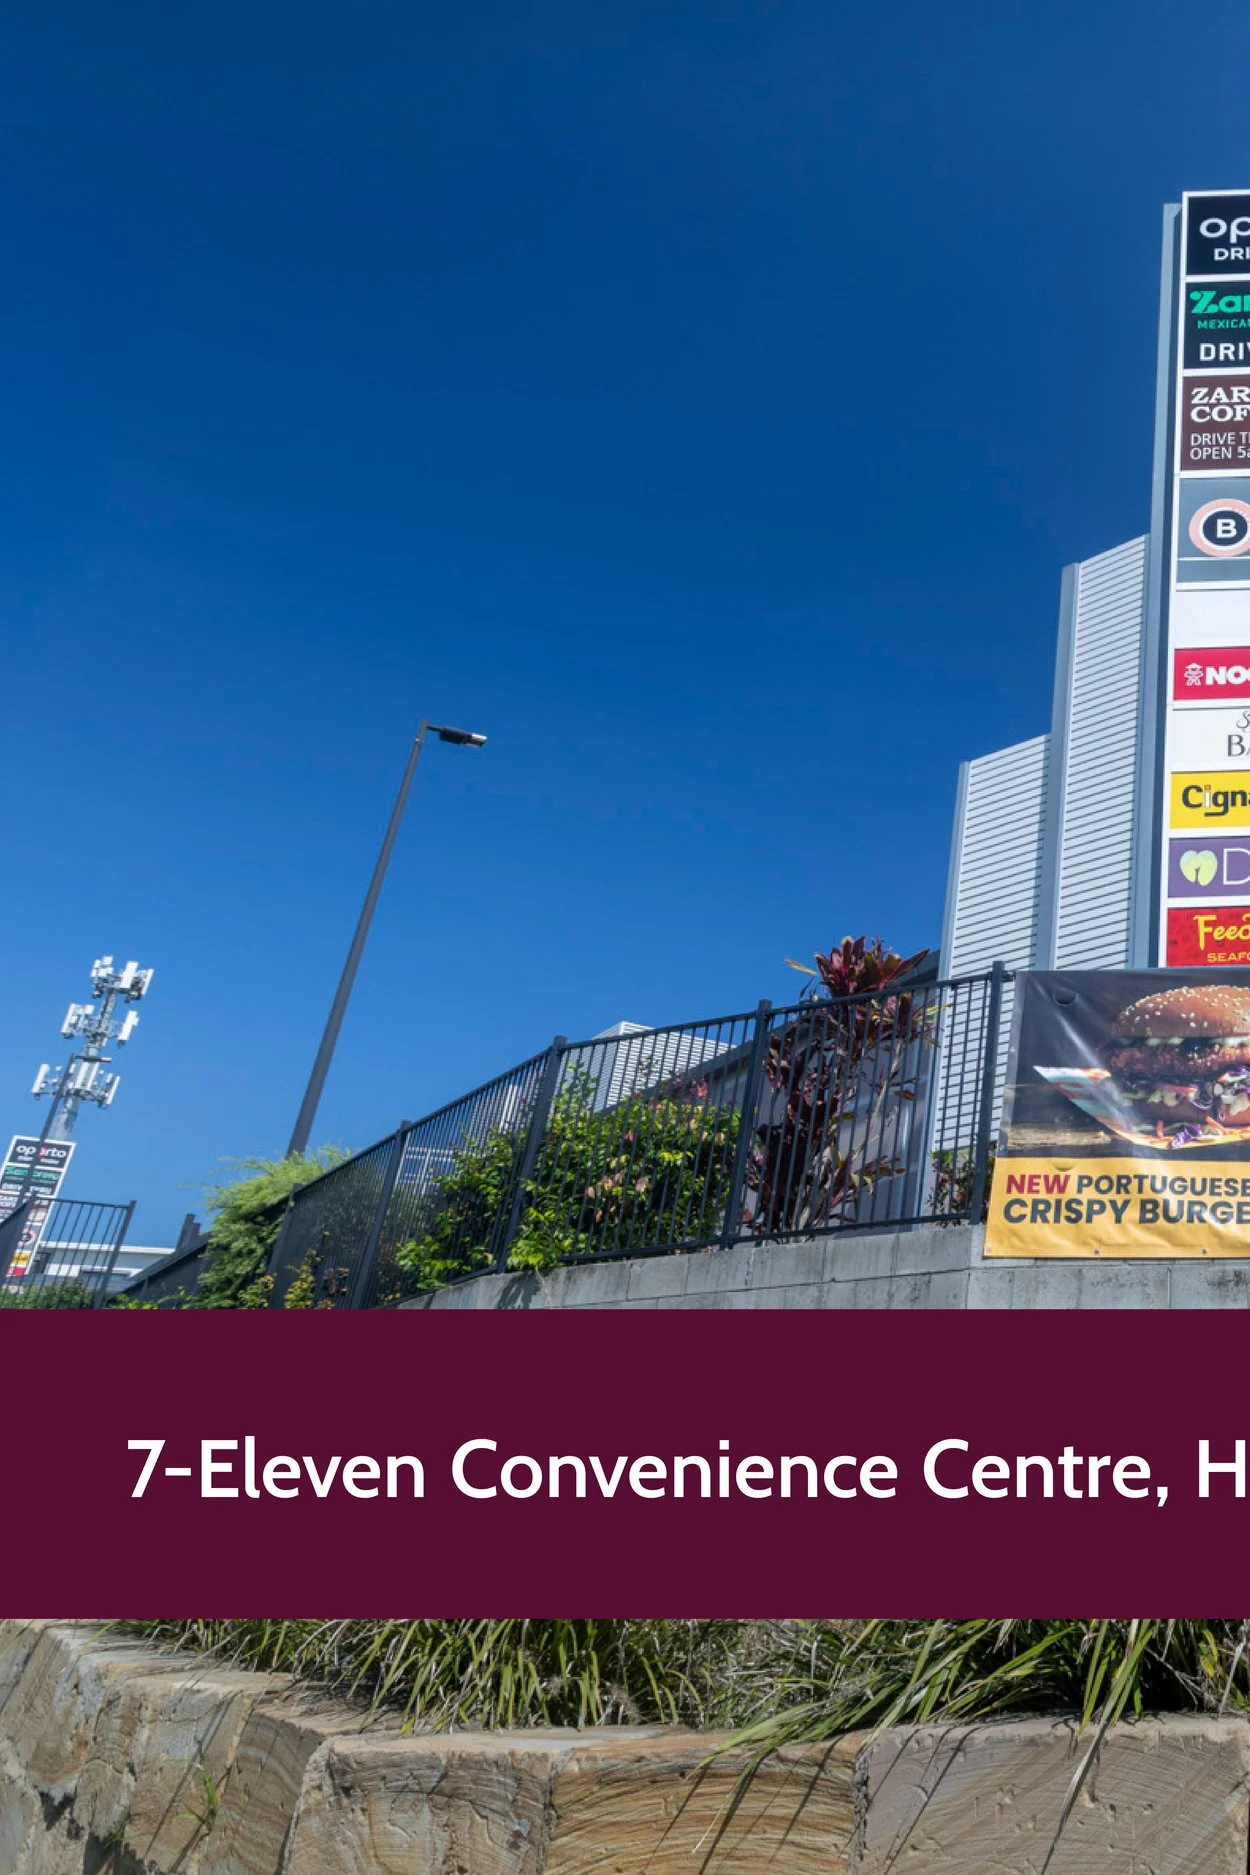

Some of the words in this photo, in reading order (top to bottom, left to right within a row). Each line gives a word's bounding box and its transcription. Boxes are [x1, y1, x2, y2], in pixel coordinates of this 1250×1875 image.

[1190, 431, 1236, 447] DRIVE
[1190, 446, 1232, 460] OPEN
[1006, 1174, 1071, 1195] NEW
[1003, 1198, 1133, 1225] CRISPY
